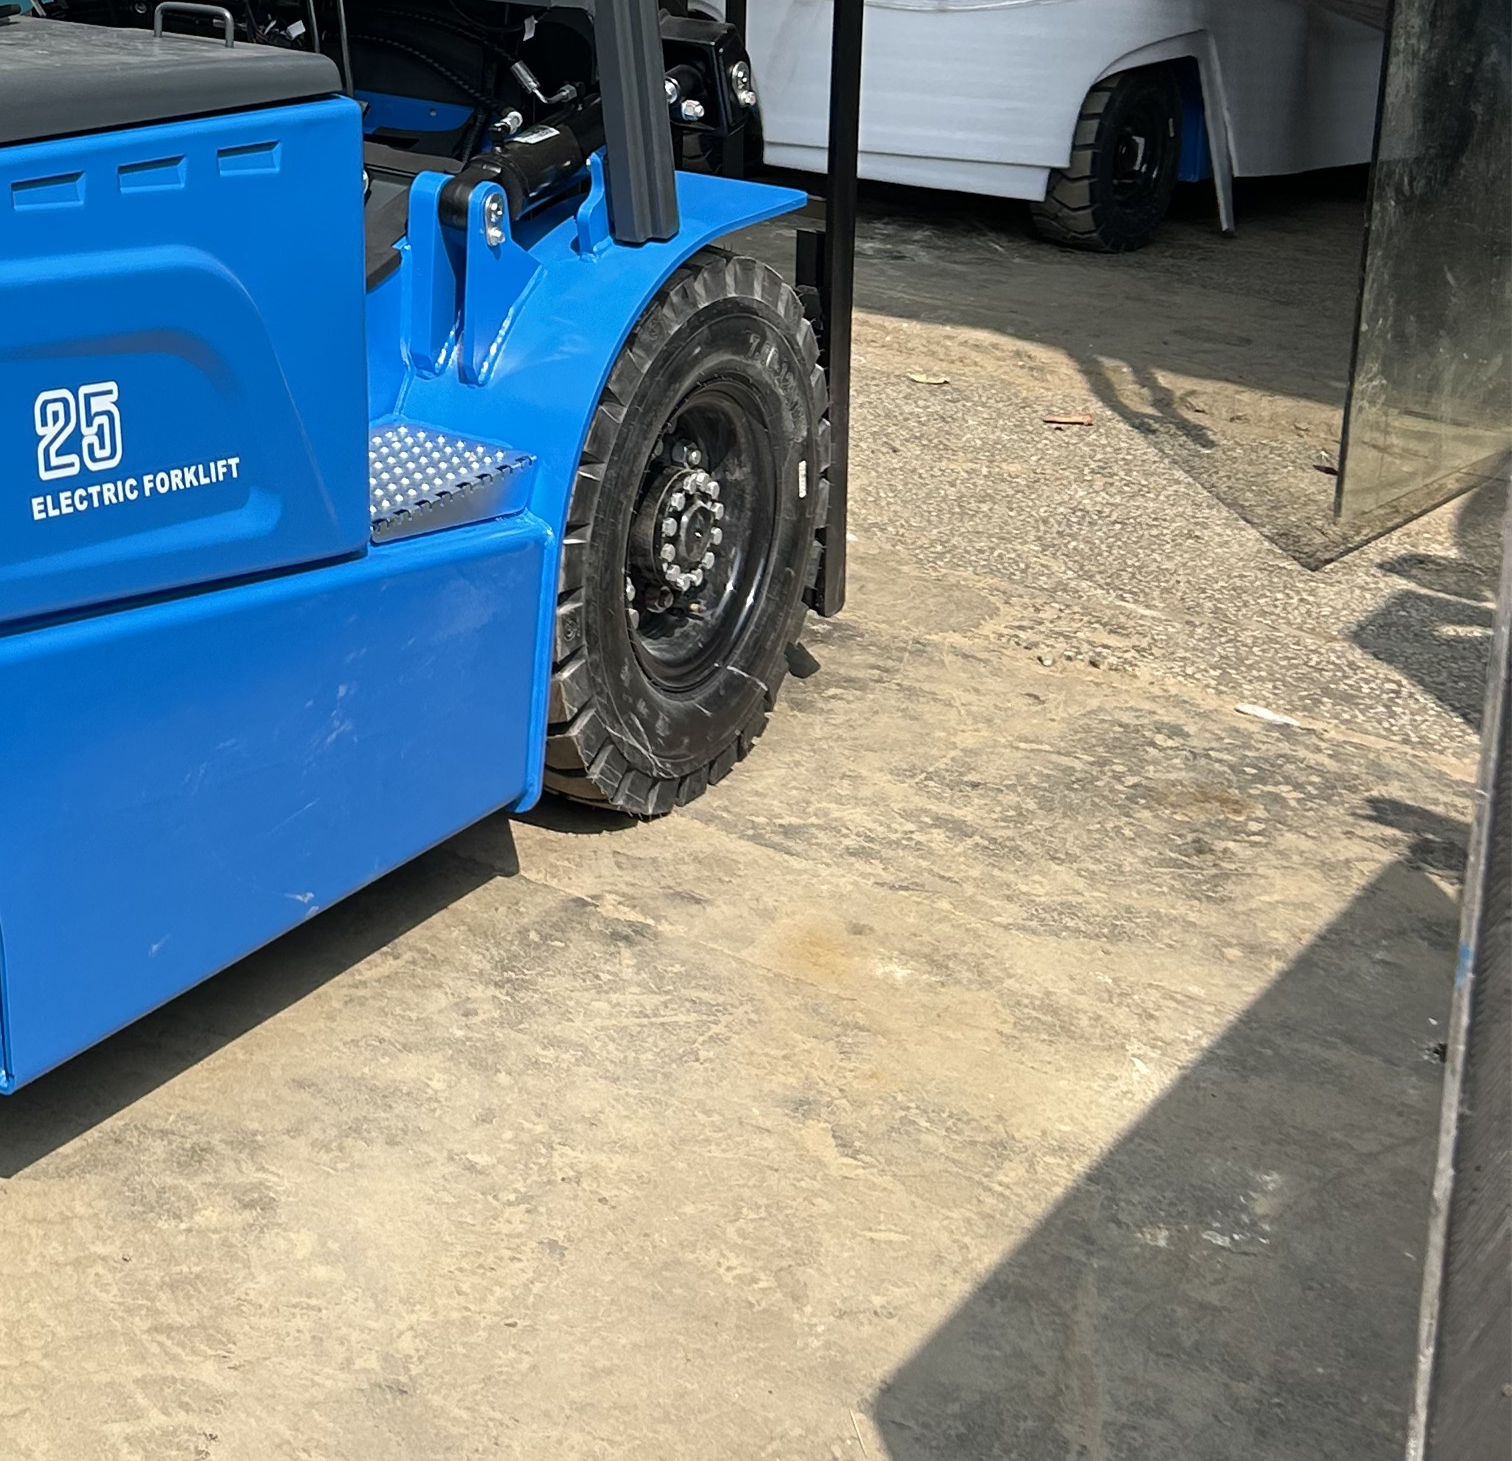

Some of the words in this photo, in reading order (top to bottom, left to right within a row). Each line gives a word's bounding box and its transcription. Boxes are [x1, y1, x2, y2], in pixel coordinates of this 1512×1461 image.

[34, 380, 123, 481] 25
[31, 477, 139, 521] ELECTRIC
[142, 456, 240, 497] FORKLIFT
